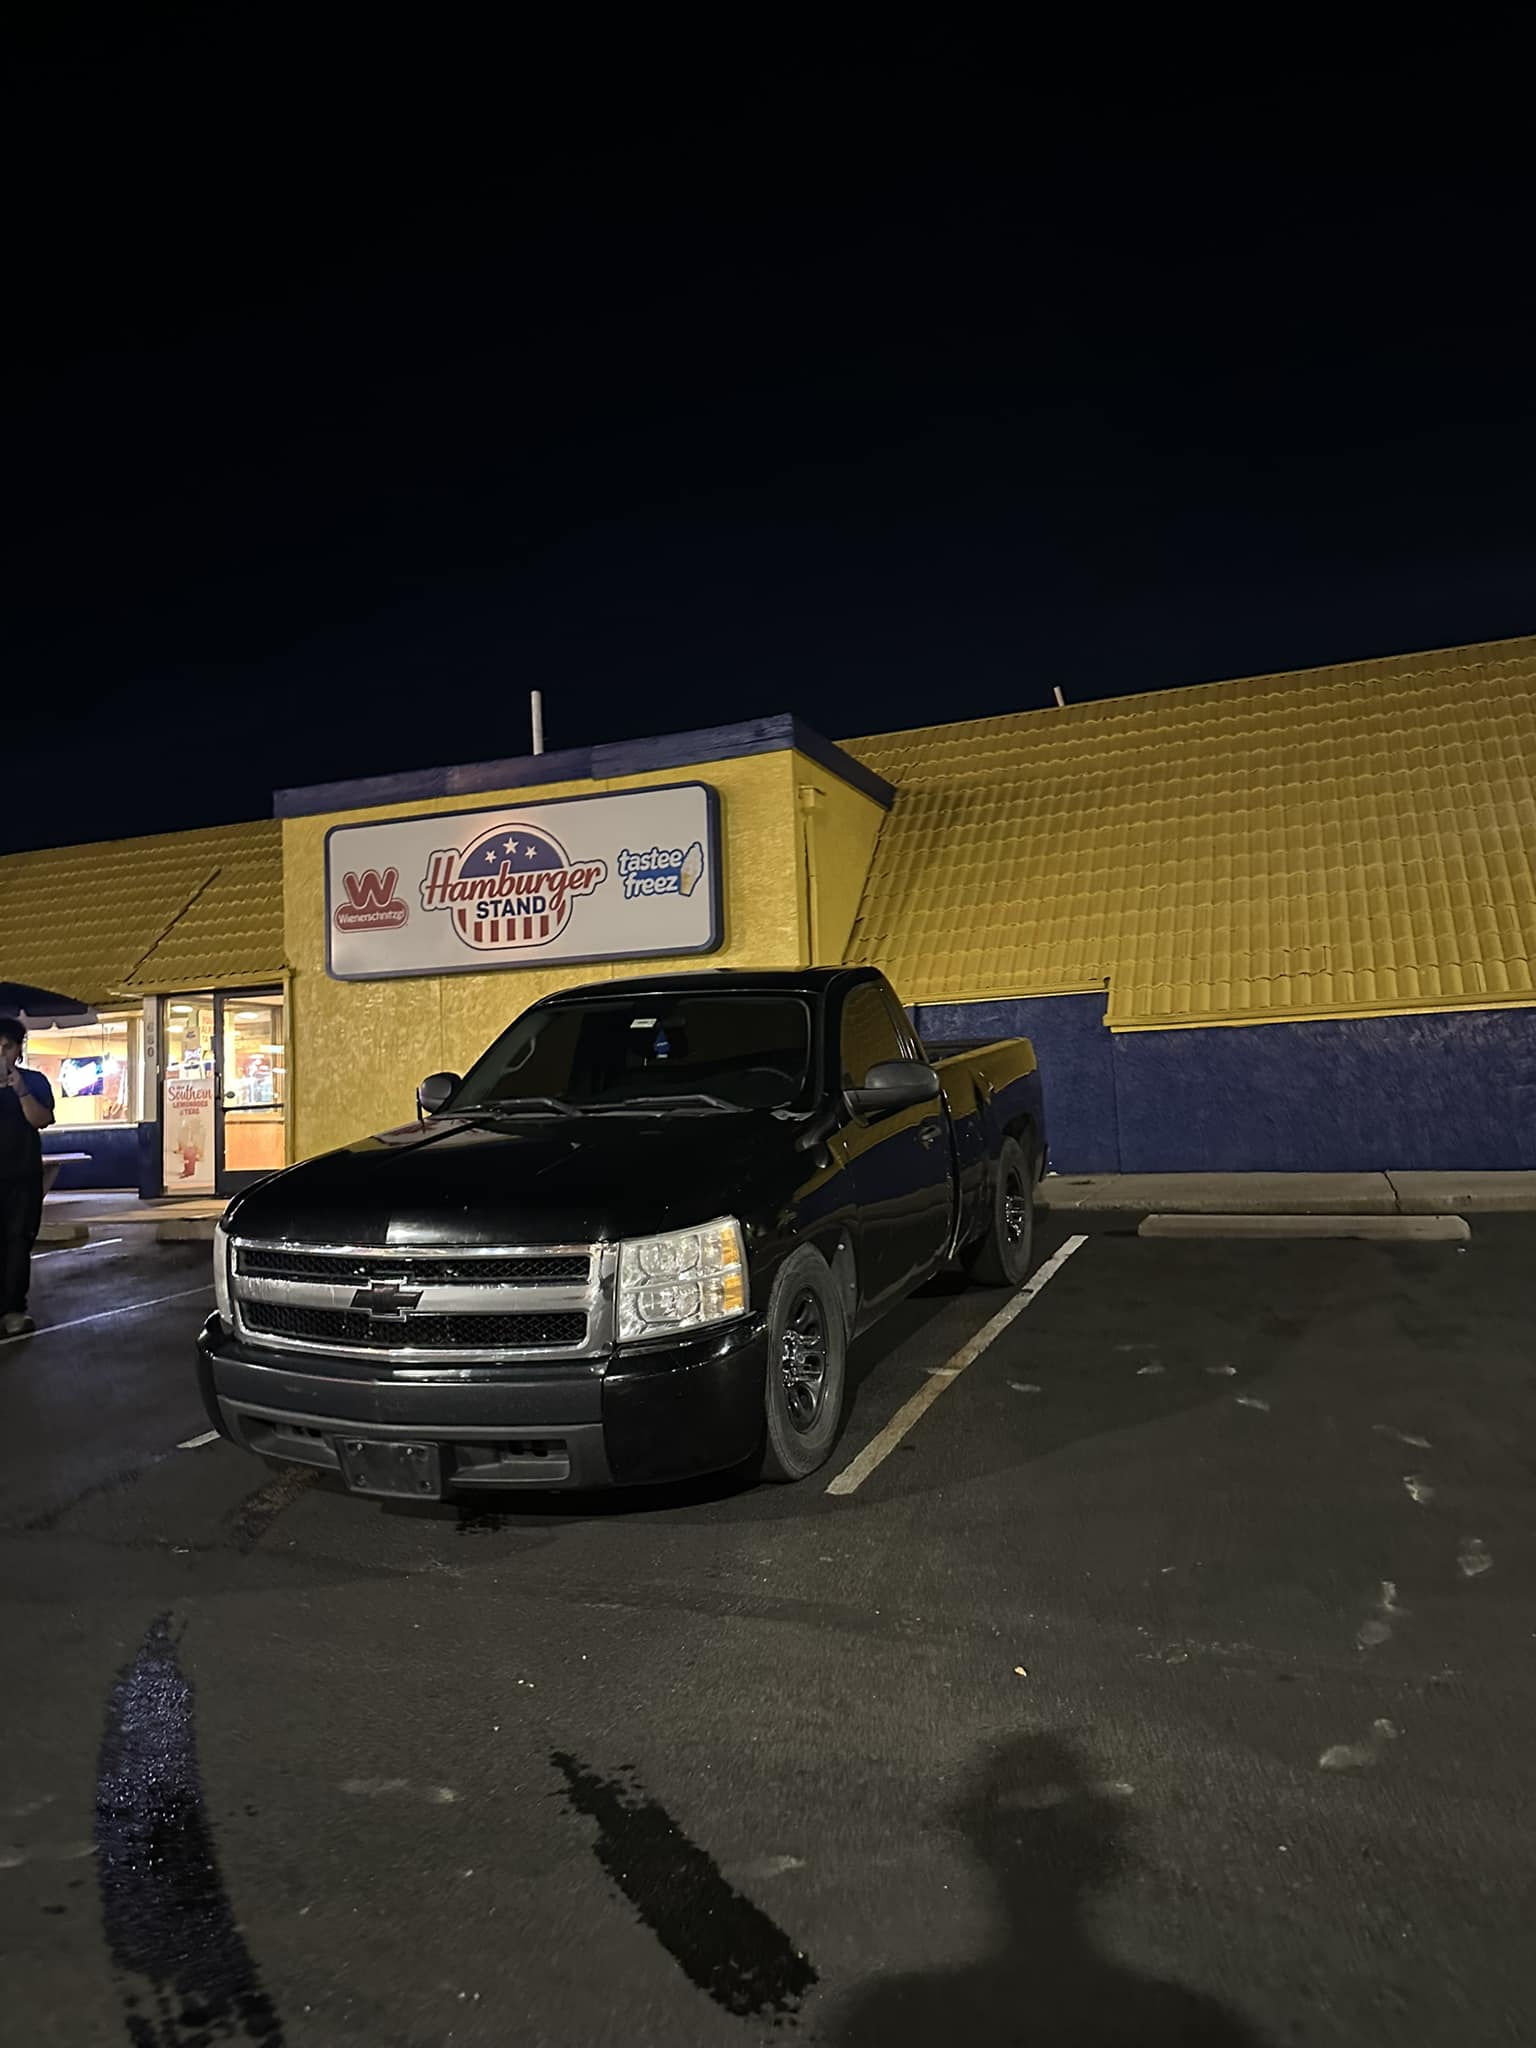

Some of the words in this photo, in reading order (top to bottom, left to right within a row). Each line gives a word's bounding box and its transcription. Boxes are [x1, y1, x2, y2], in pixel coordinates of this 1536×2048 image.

[618, 848, 683, 876] tastee
[343, 867, 399, 909] W
[426, 855, 601, 910] Hamburger
[625, 872, 679, 899] freez
[476, 895, 546, 919] STAND
[168, 1084, 213, 1101] Southern
